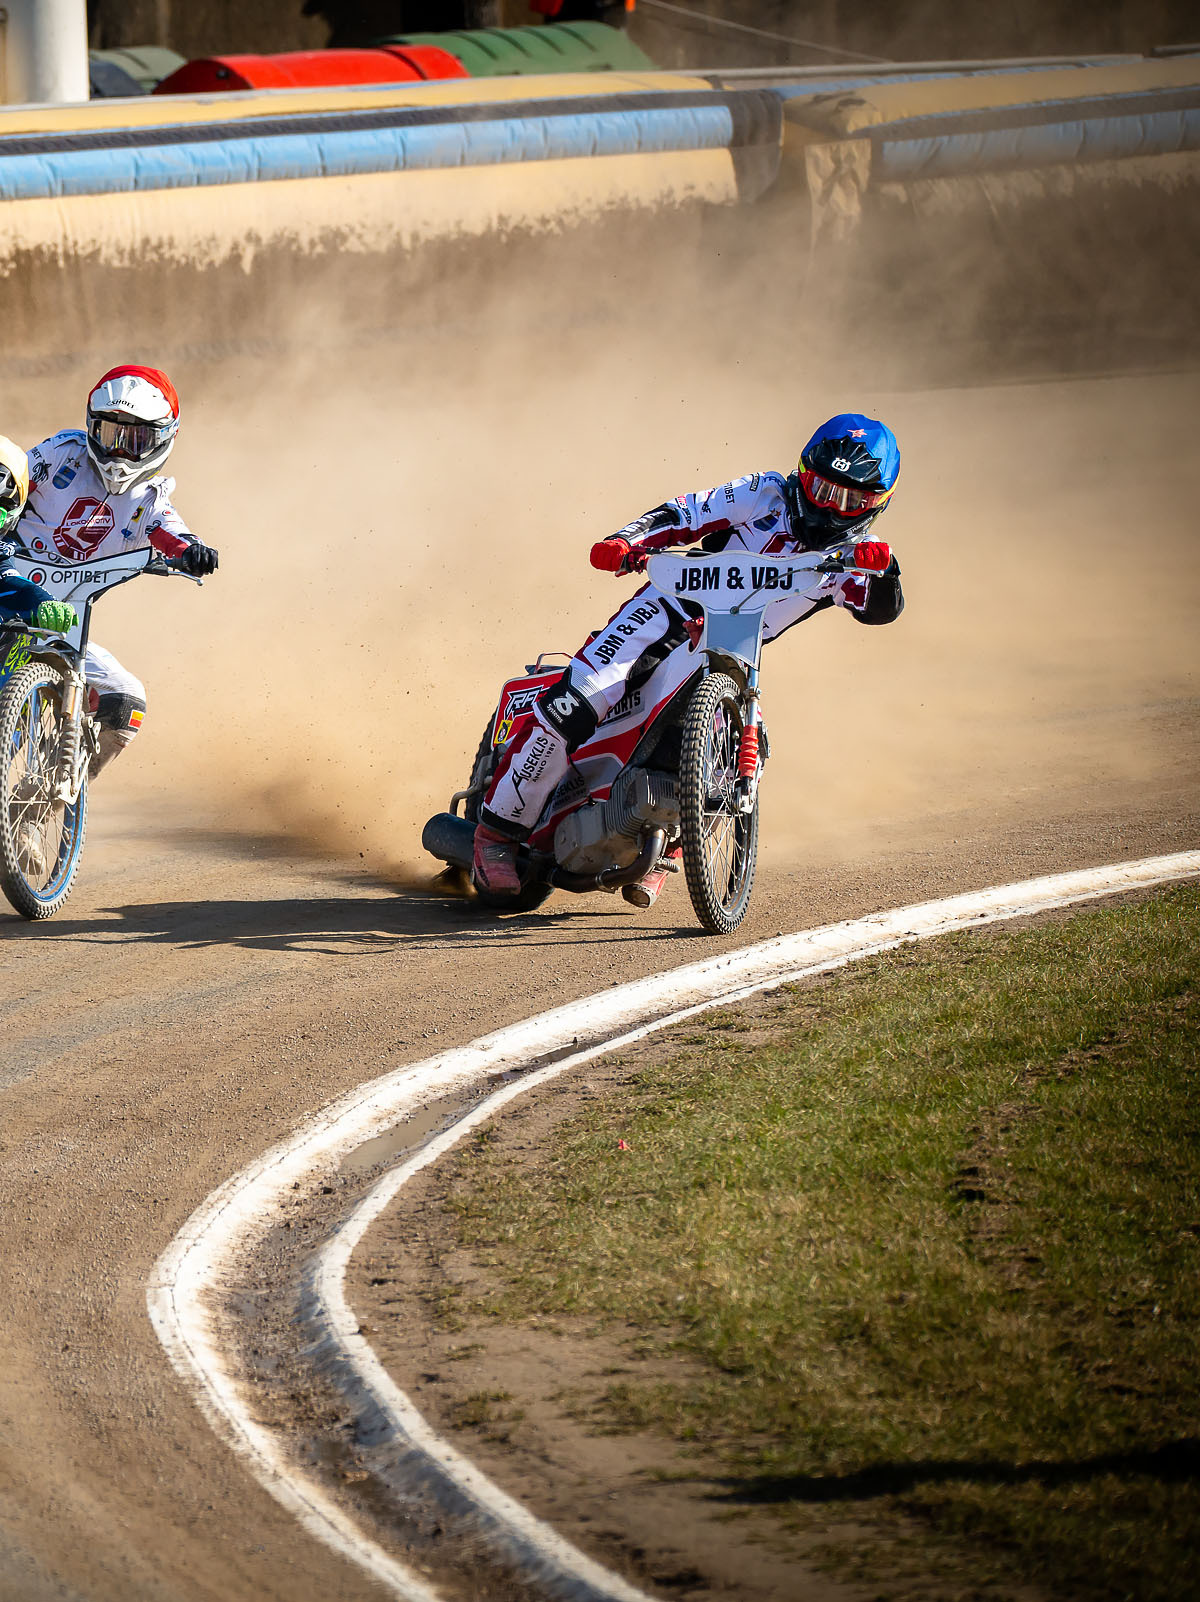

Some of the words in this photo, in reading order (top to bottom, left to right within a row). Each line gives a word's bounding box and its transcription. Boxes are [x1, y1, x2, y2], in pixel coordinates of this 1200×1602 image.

[51, 570, 109, 583] OPTIBET
[675, 567, 721, 592] JBM
[726, 566, 745, 590] &
[751, 566, 794, 591] VBJ
[594, 634, 626, 665] JBM
[616, 623, 638, 636] &
[627, 601, 660, 626] VBJ
[546, 703, 563, 723] Systems
[607, 690, 641, 719] PORTS
[532, 760, 547, 783] ANNO
[545, 742, 556, 758] 1989
[557, 776, 586, 797] SEKLIS
[511, 804, 525, 818] IK
